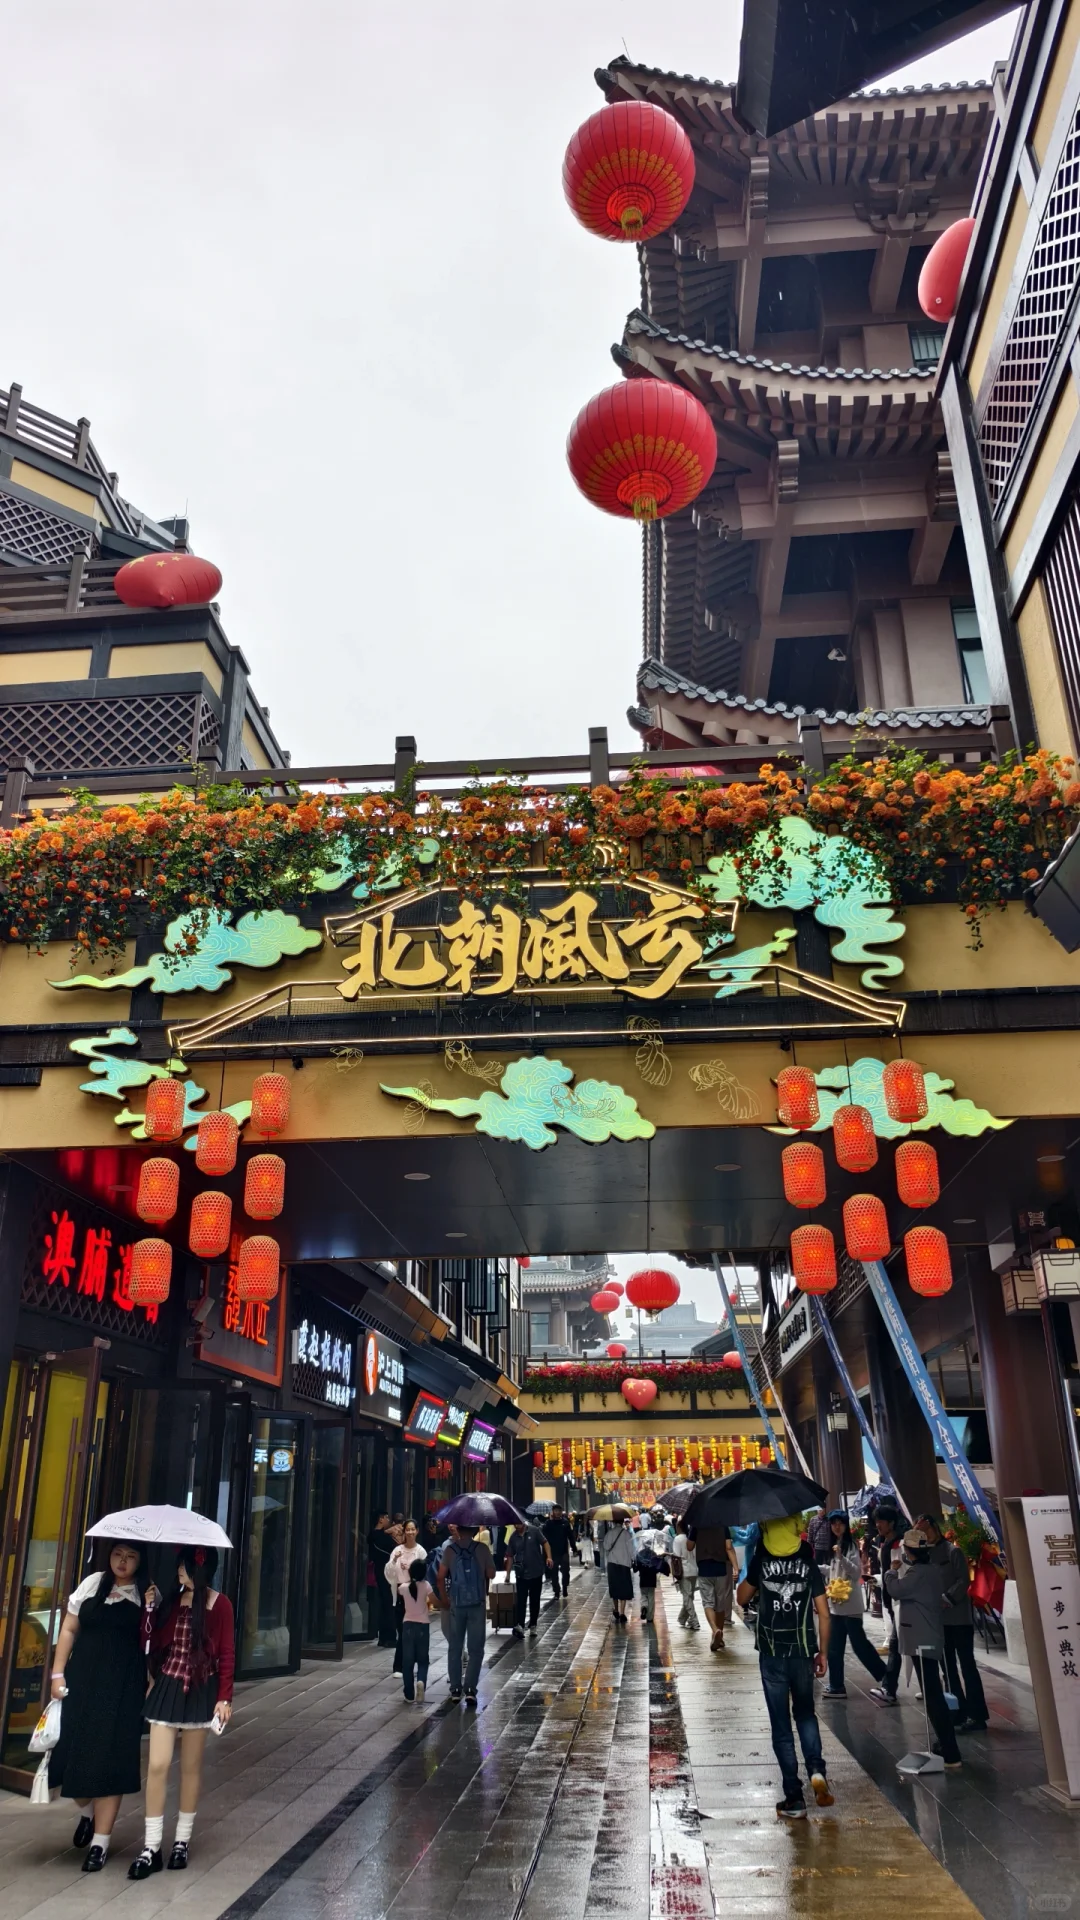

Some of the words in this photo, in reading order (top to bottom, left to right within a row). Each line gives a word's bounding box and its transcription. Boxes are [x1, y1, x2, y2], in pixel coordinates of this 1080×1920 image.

[773, 1600, 801, 1612] BOY
[1050, 1586, 1079, 1678] 一步一典故
